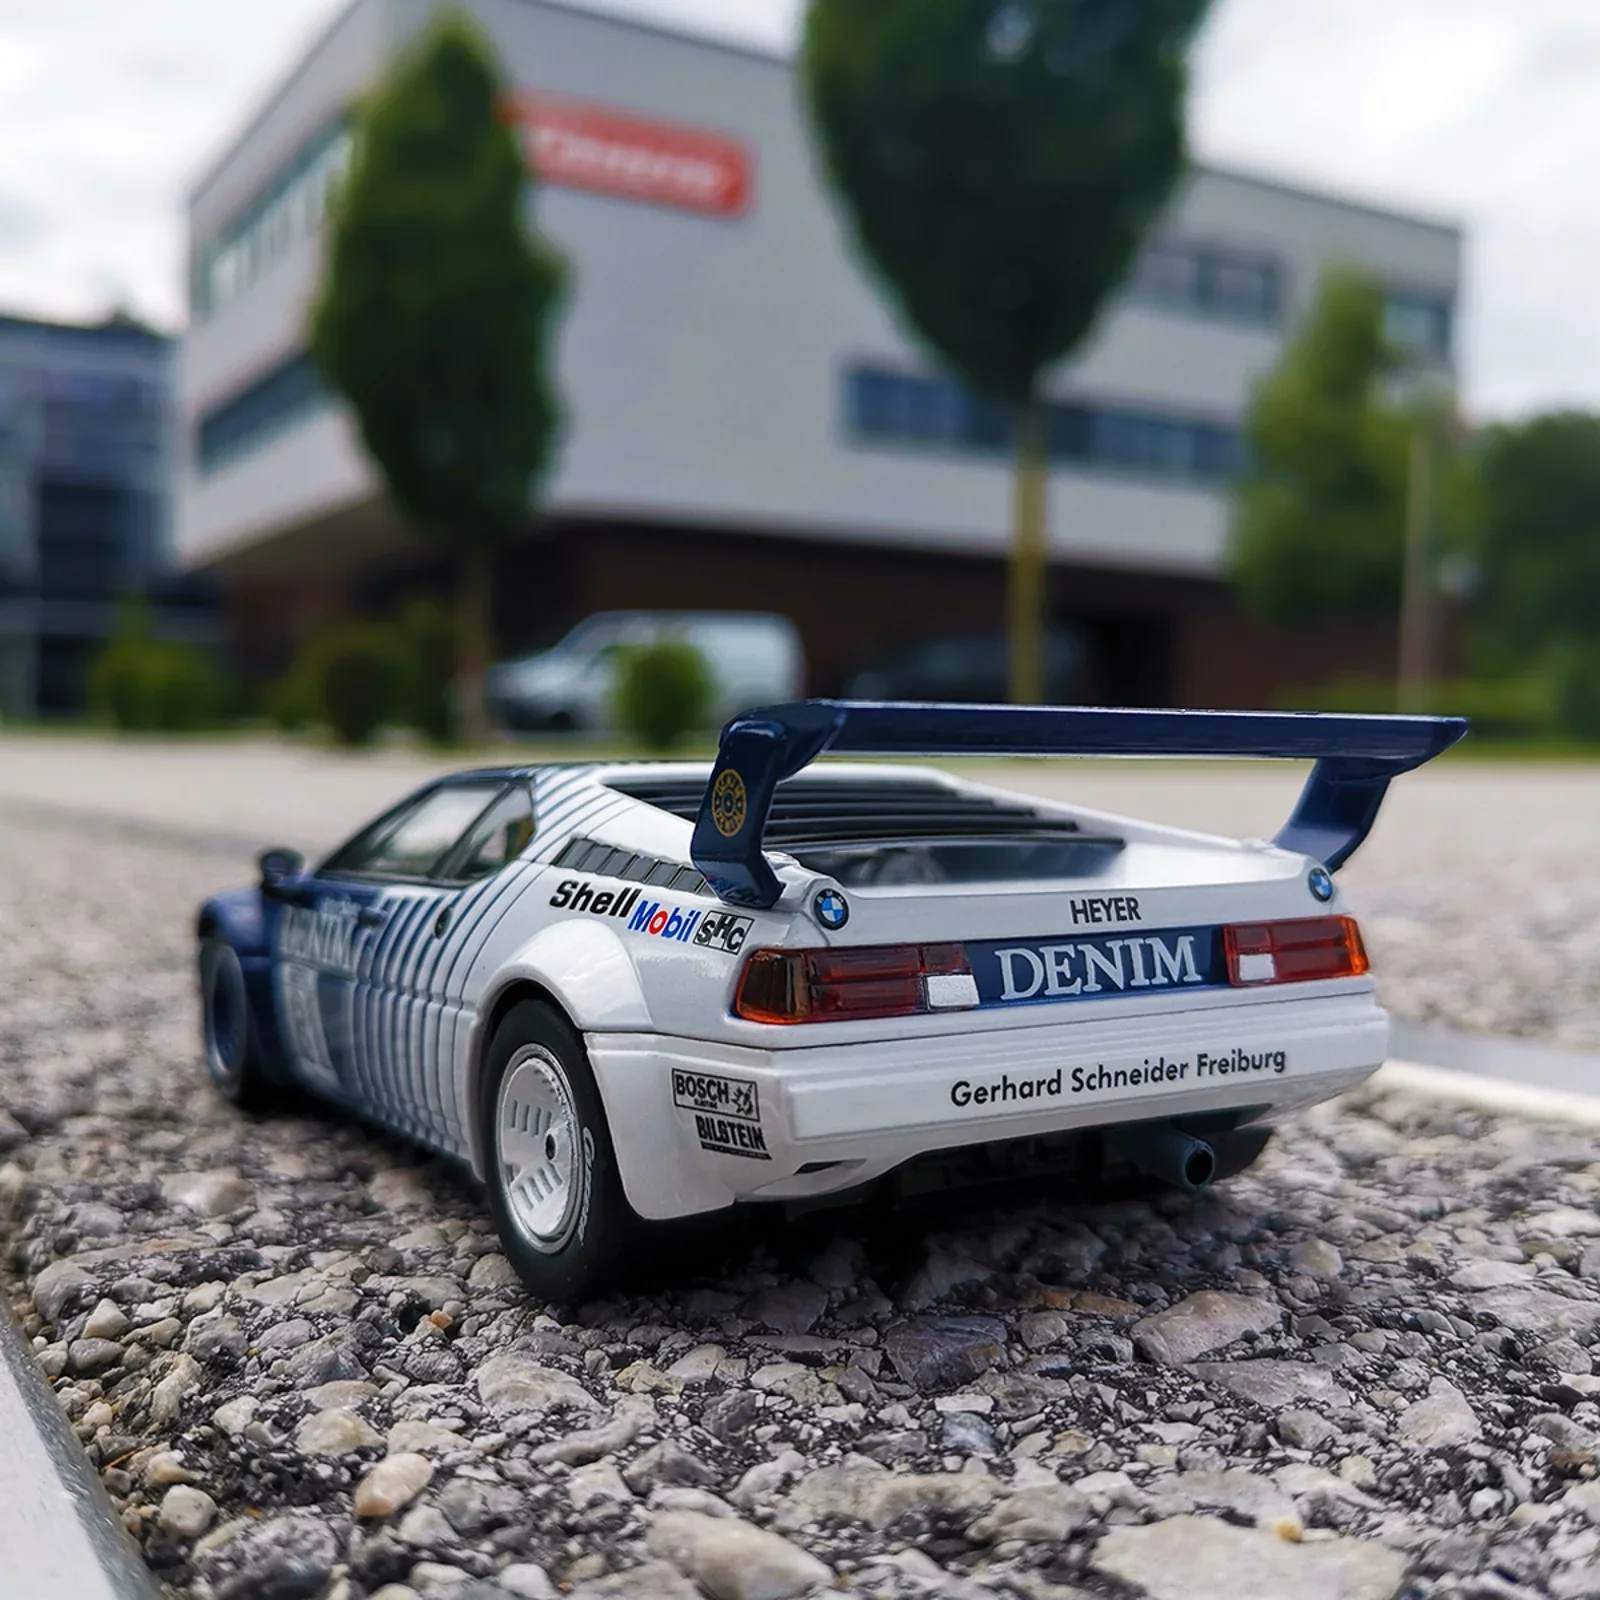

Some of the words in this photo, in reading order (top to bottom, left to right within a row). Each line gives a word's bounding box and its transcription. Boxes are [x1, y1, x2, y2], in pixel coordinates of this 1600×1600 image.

[549, 880, 642, 918] Shell
[628, 900, 702, 943] Mobil
[696, 913, 745, 951] SHC
[1069, 897, 1142, 924] HEYER
[995, 936, 1202, 1001] DENIM
[675, 1074, 730, 1104] BOSCH
[951, 1069, 1062, 1107] Gerhard
[1071, 1057, 1189, 1093] Schneider
[1197, 1048, 1286, 1075] Freiburg
[695, 1114, 767, 1151] BILSTEIN
